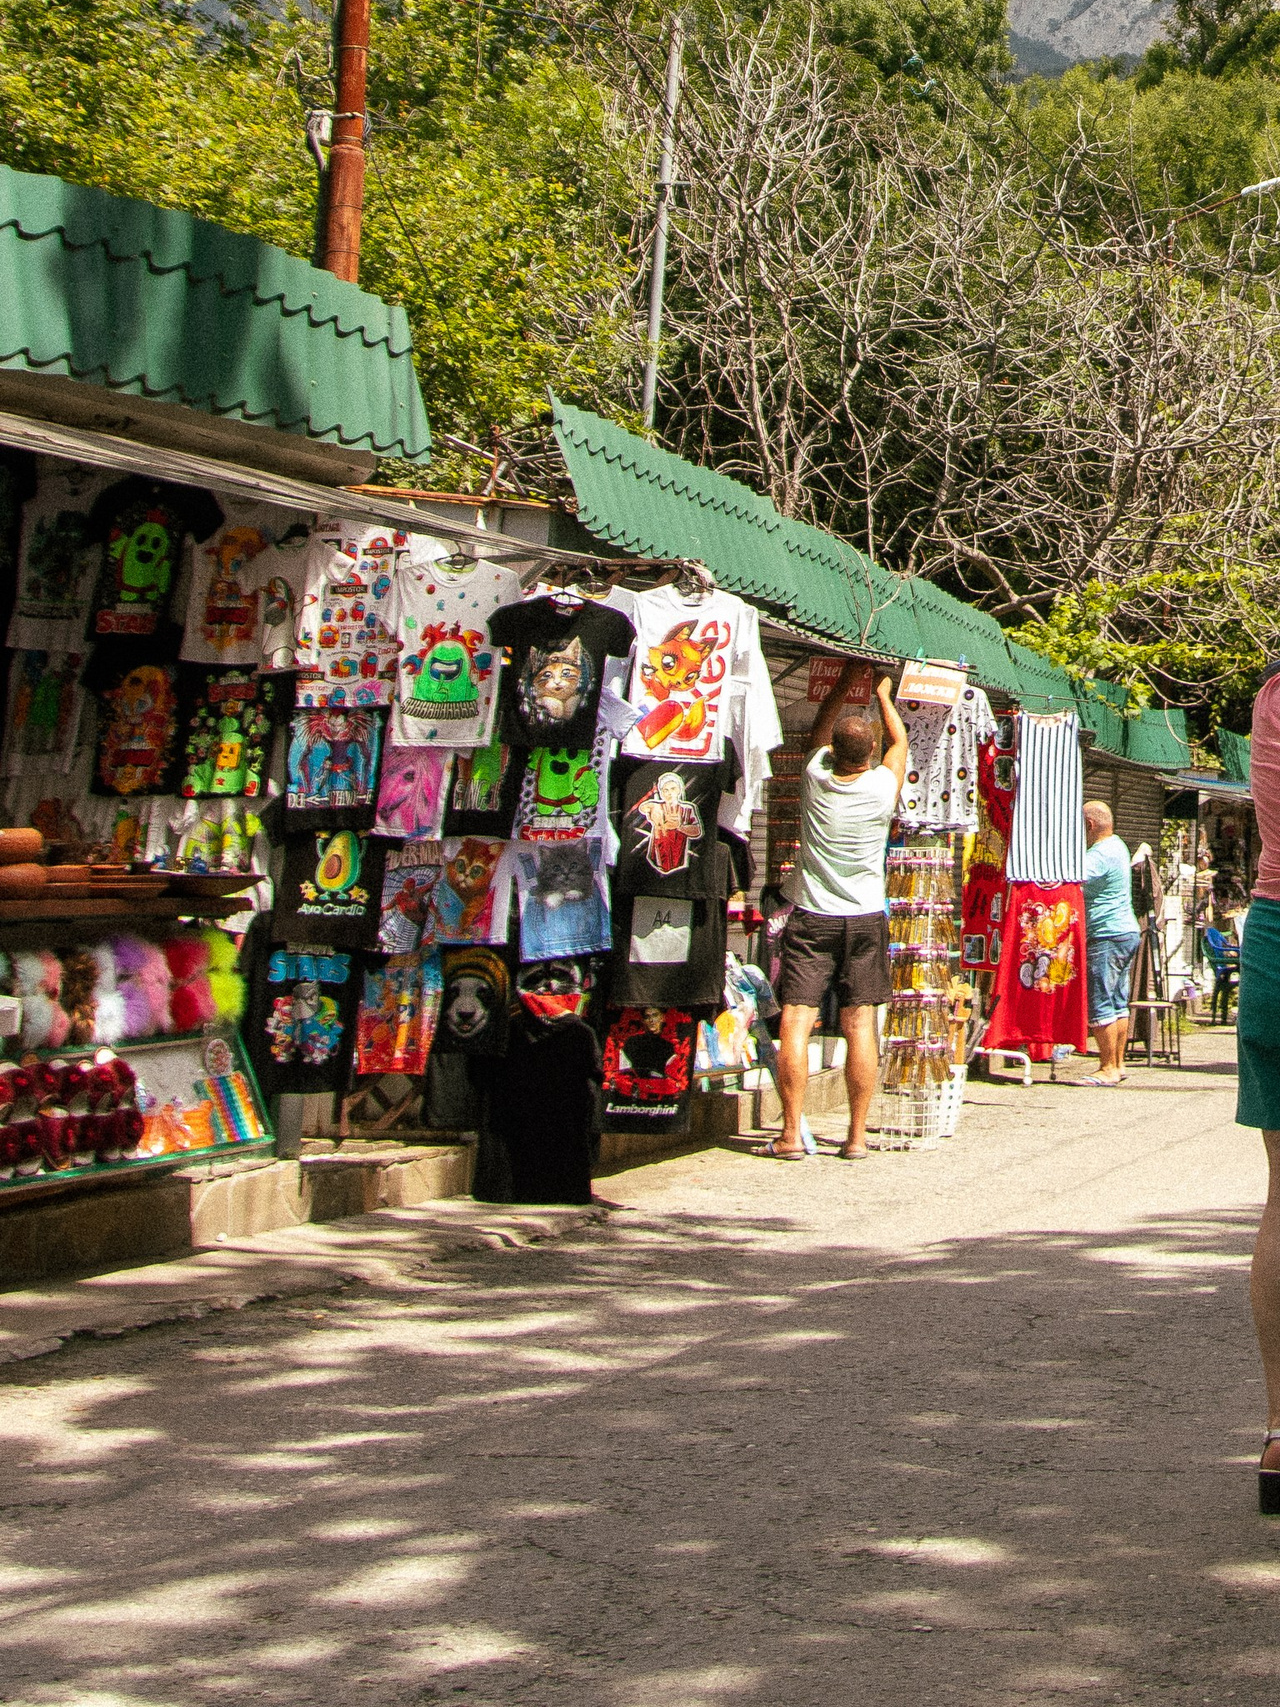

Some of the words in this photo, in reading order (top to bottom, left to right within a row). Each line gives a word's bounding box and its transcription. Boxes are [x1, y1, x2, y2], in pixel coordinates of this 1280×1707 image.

[652, 909, 671, 927] A4
[267, 949, 352, 984] STARS
[605, 1102, 679, 1117] Lamborghini
